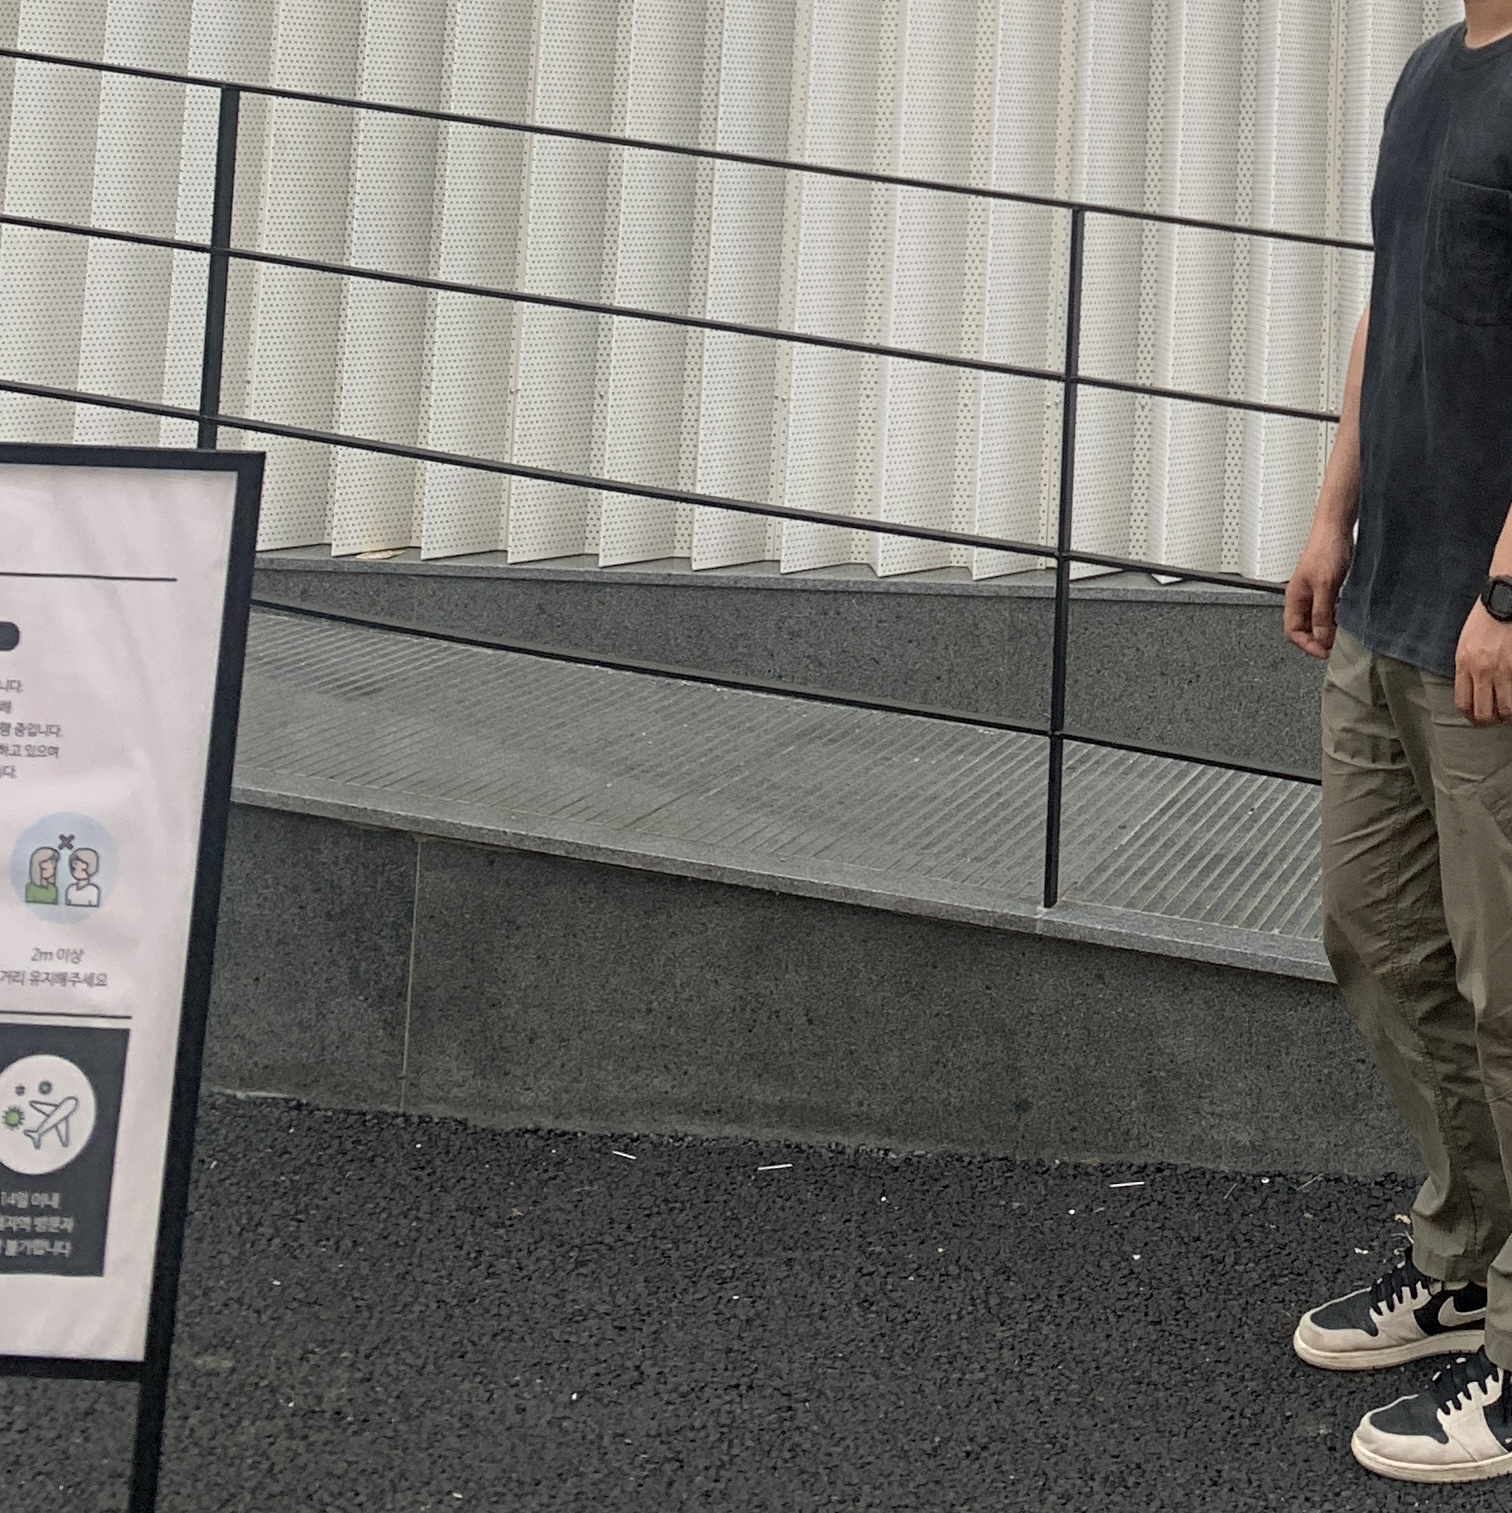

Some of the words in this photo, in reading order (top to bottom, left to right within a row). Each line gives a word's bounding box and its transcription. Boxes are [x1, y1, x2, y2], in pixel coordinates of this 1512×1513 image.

[31, 947, 54, 962] 2m
[55, 948, 85, 965] 이상
[28, 970, 108, 987] 유지해주세요
